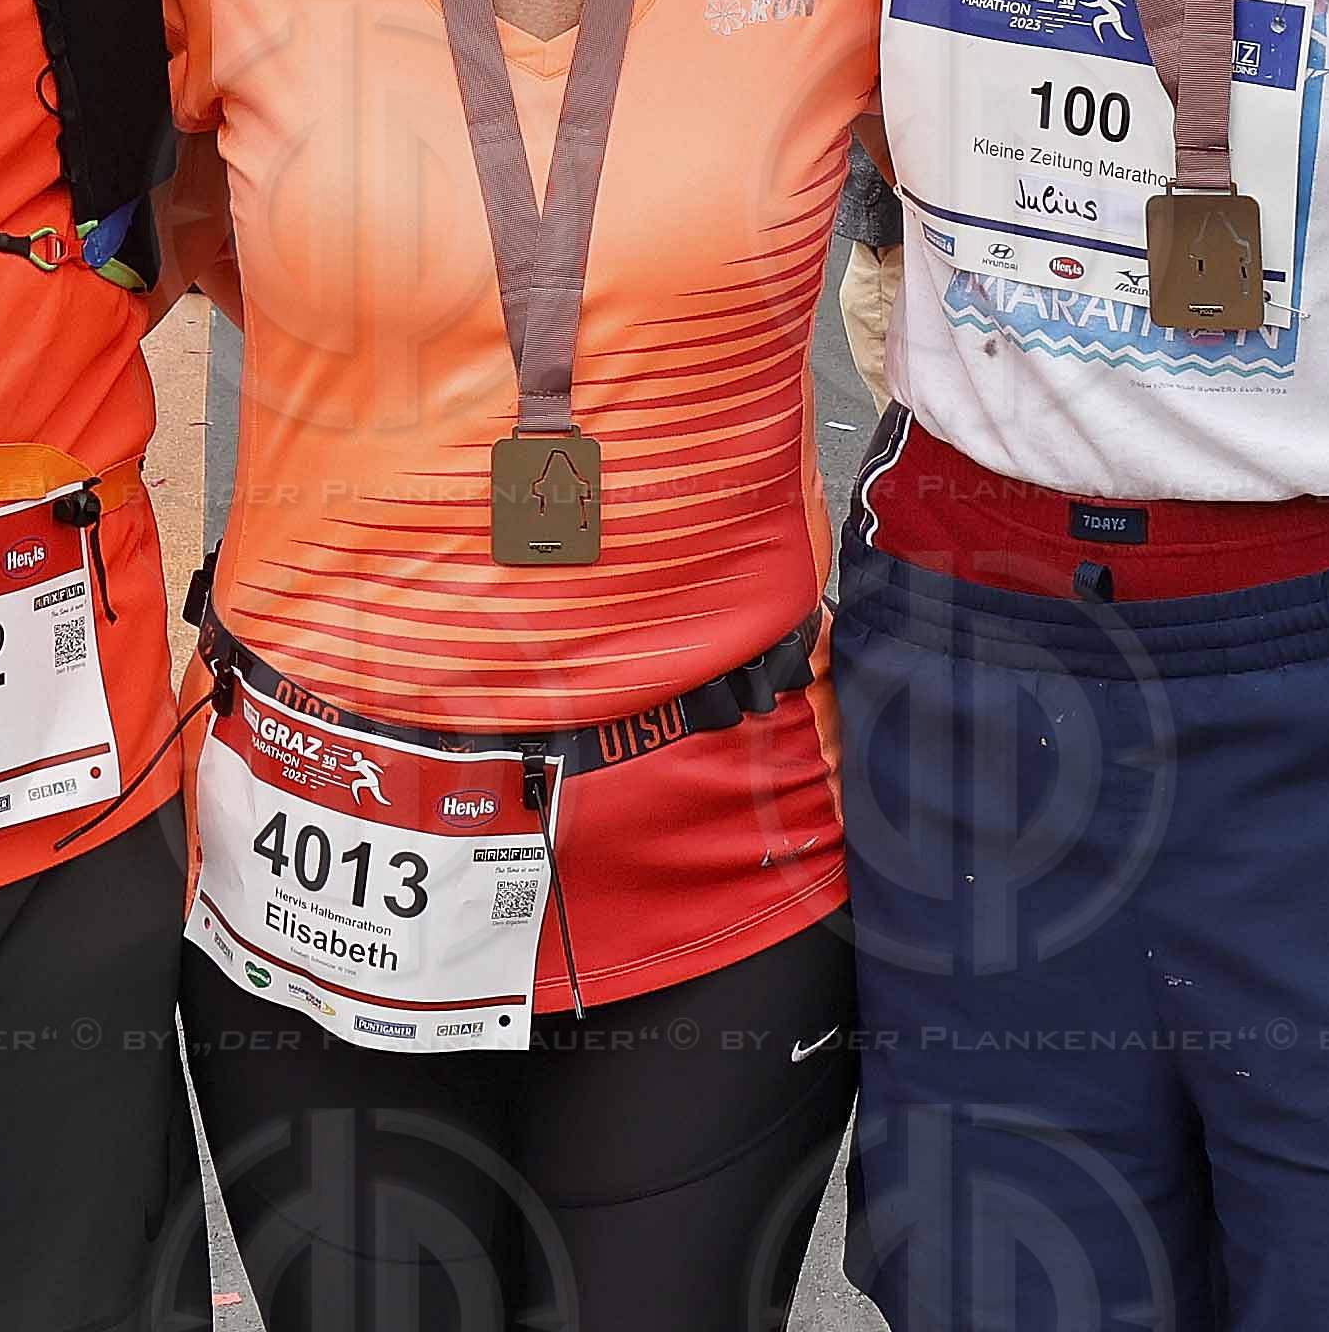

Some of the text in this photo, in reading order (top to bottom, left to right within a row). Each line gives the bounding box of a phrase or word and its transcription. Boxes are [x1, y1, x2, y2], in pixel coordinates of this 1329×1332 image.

[1009, 17, 1042, 32] 2023
[1031, 80, 1131, 143] 100
[973, 137, 1025, 161] Kleine
[1031, 147, 1093, 177] Zeitung
[1015, 179, 1098, 222] Julius
[982, 258, 1019, 271] HYUNDAI
[1052, 258, 1085, 278] Hervis
[1082, 514, 1127, 531] 7DAYS
[7, 545, 45, 570] Hervis
[260, 717, 337, 767] GRAZ 30
[282, 767, 308, 785] 2023
[28, 779, 77, 801] GRAZ
[443, 796, 495, 818] Hervis
[252, 811, 429, 918] 4013
[275, 887, 392, 936] Hervis Halbmarathon
[265, 901, 398, 972] Elisabeth
[357, 1018, 413, 1037] PUNTIGAMER
[437, 1022, 483, 1037] GRAZ
